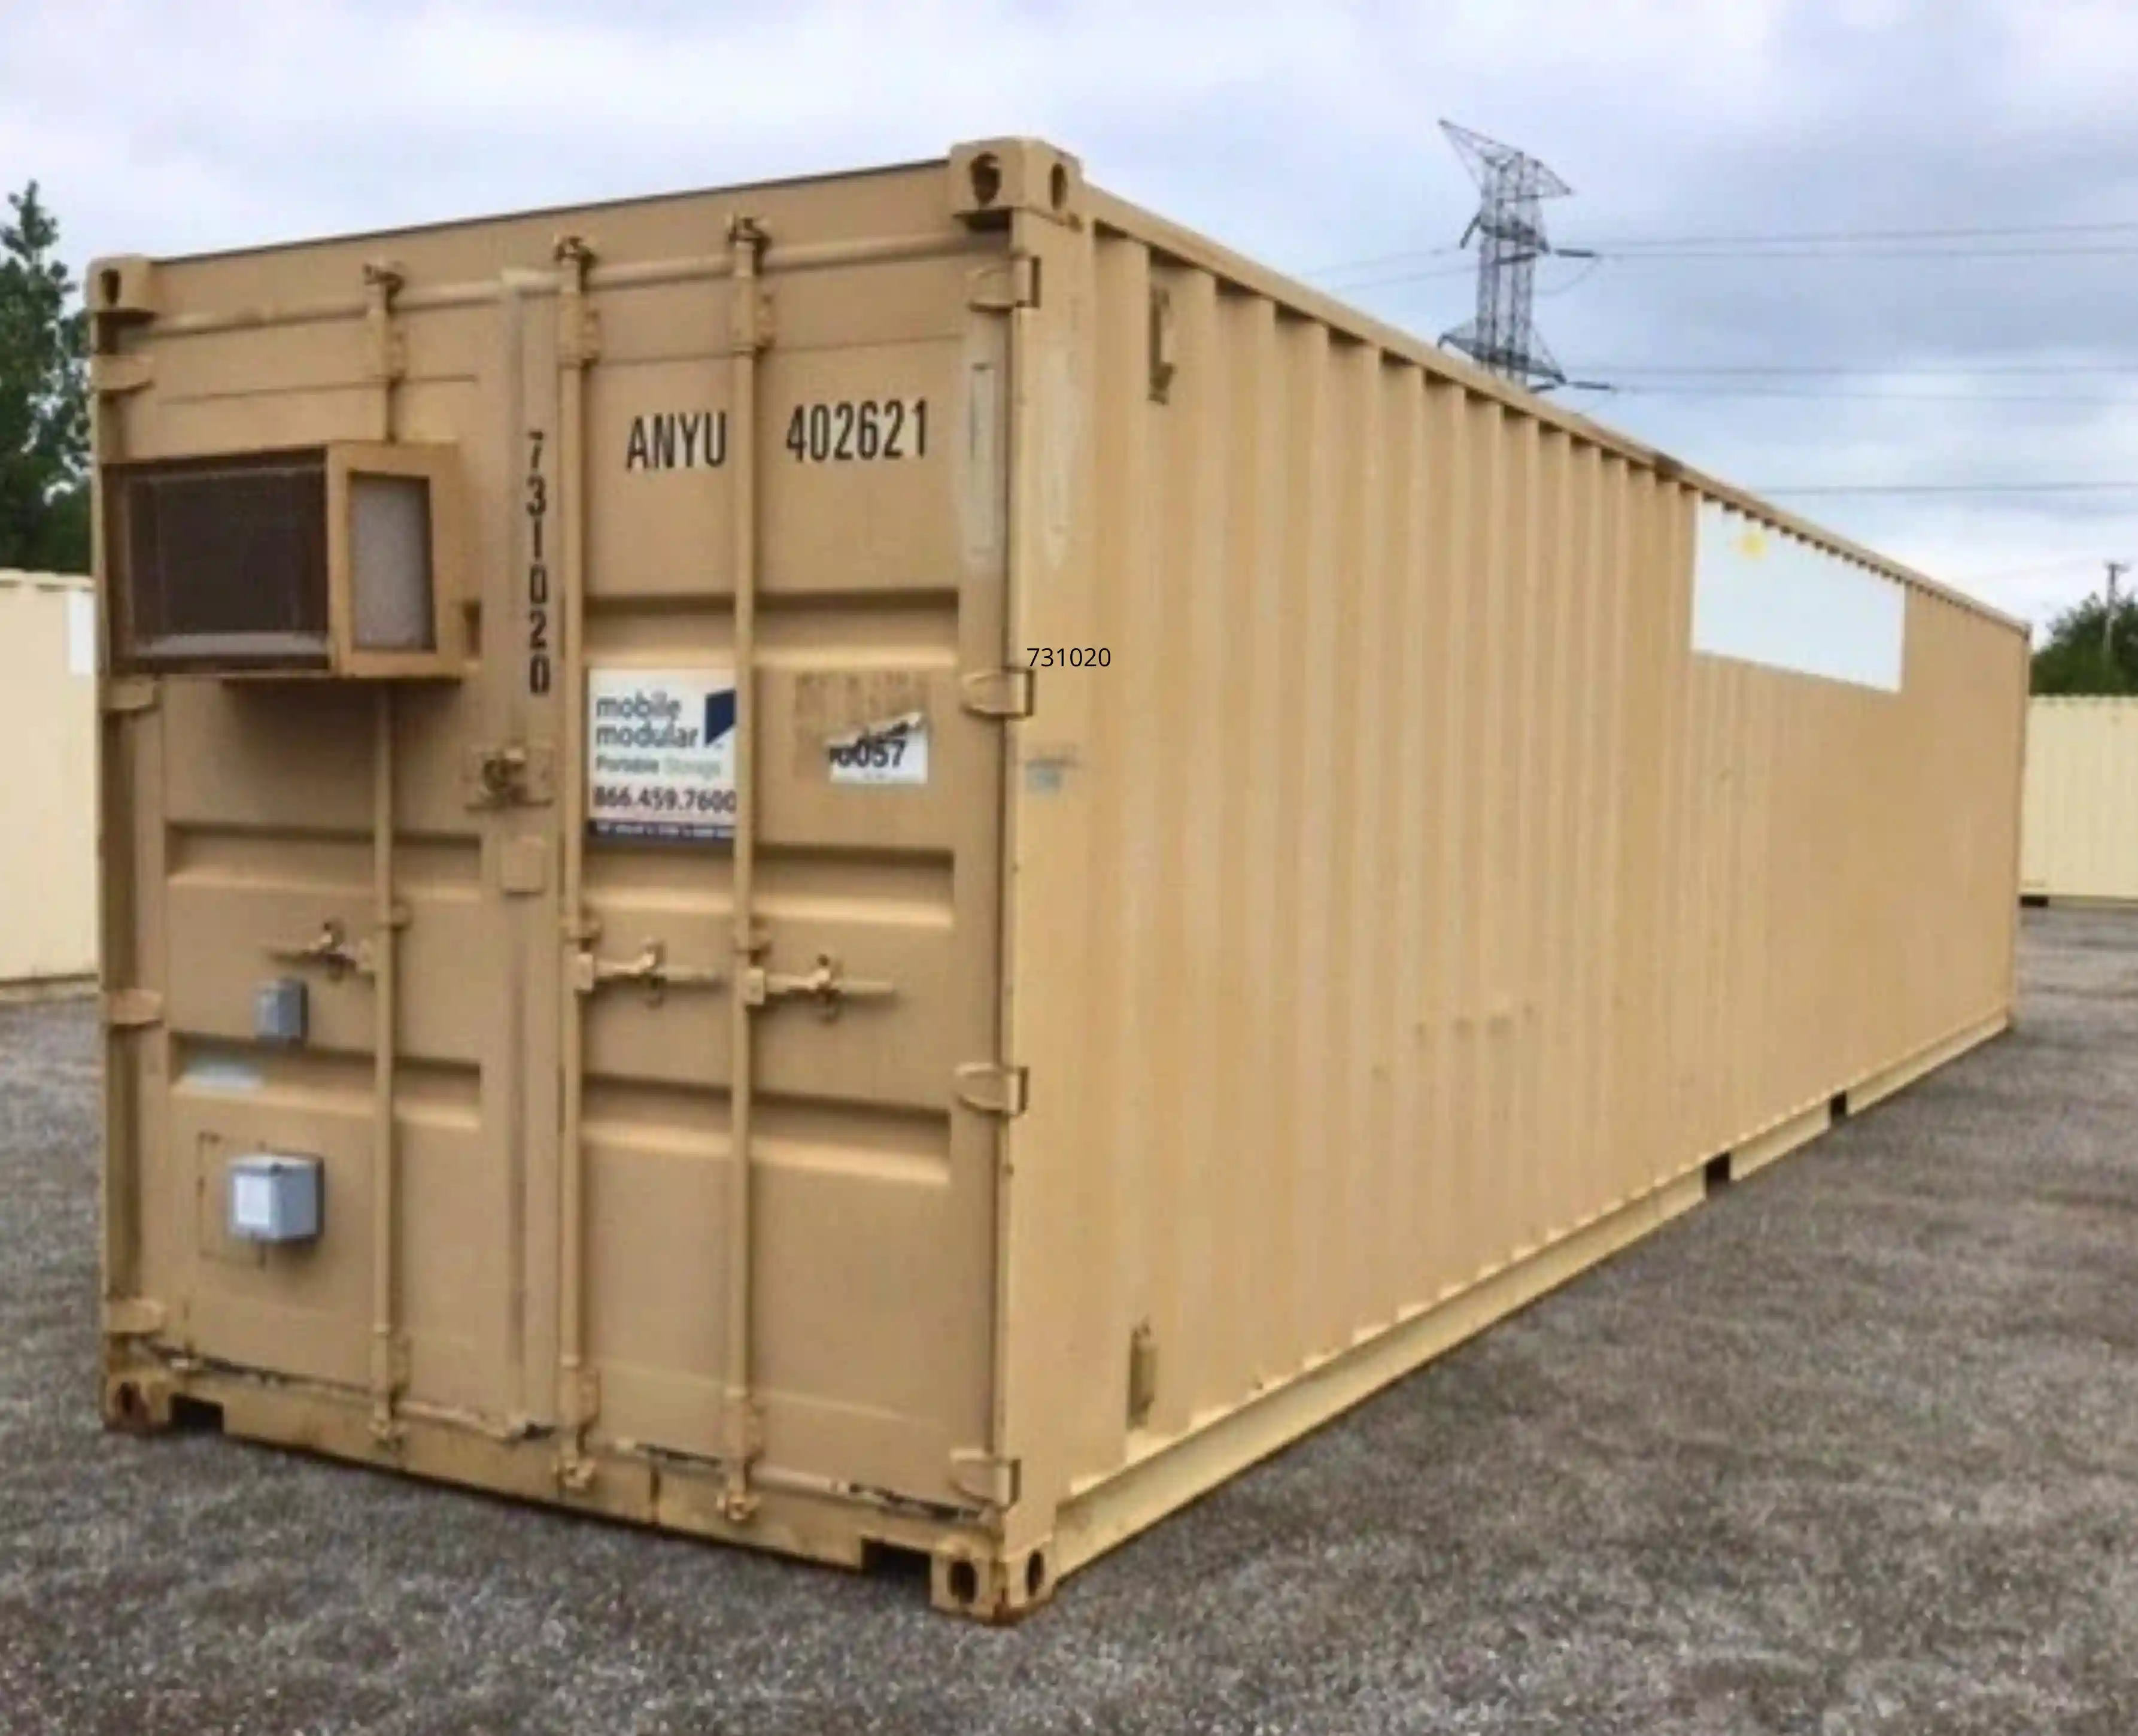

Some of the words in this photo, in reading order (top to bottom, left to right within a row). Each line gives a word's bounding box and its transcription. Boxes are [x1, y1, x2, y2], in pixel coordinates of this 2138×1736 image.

[626, 411, 727, 471] ANYU
[785, 398, 928, 463] 402621
[526, 429, 551, 696] 731020
[596, 690, 681, 720] mobile
[596, 720, 699, 748] modular
